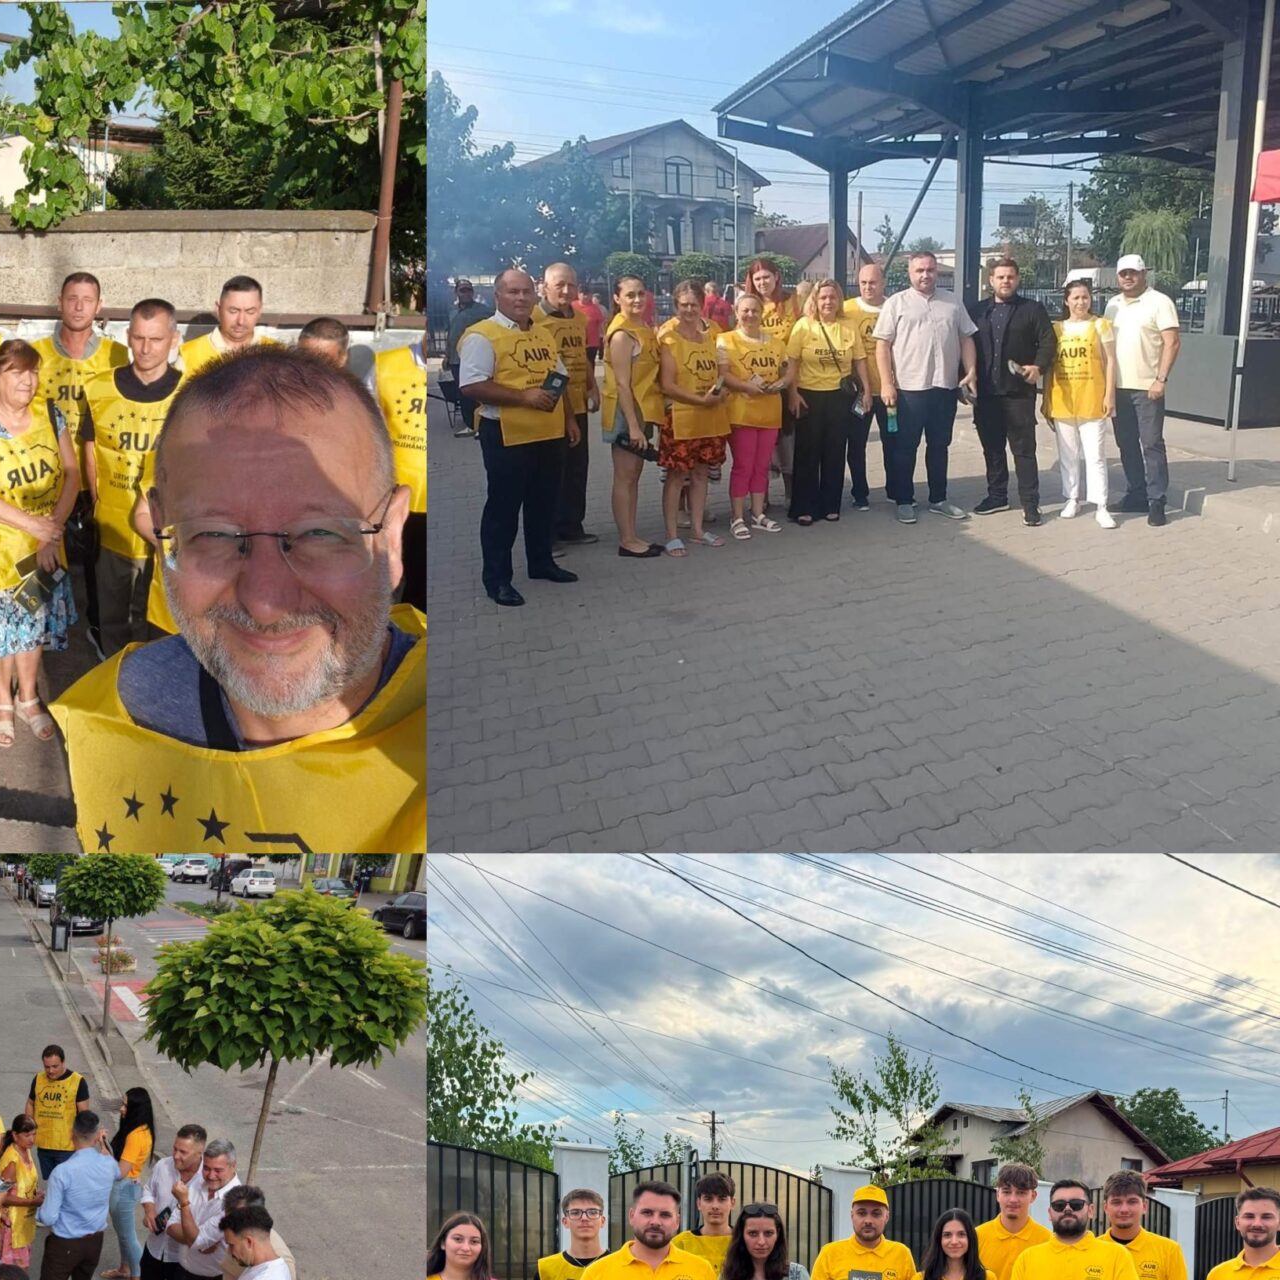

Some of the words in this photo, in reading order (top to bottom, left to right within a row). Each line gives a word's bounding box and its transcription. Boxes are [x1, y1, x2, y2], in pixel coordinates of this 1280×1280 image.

[760, 318, 784, 328] AUR
[561, 335, 583, 349] AUR
[524, 348, 552, 362] AUR
[1060, 347, 1087, 358] AUR
[750, 357, 777, 368] AUR
[43, 1091, 62, 1101] AUR
